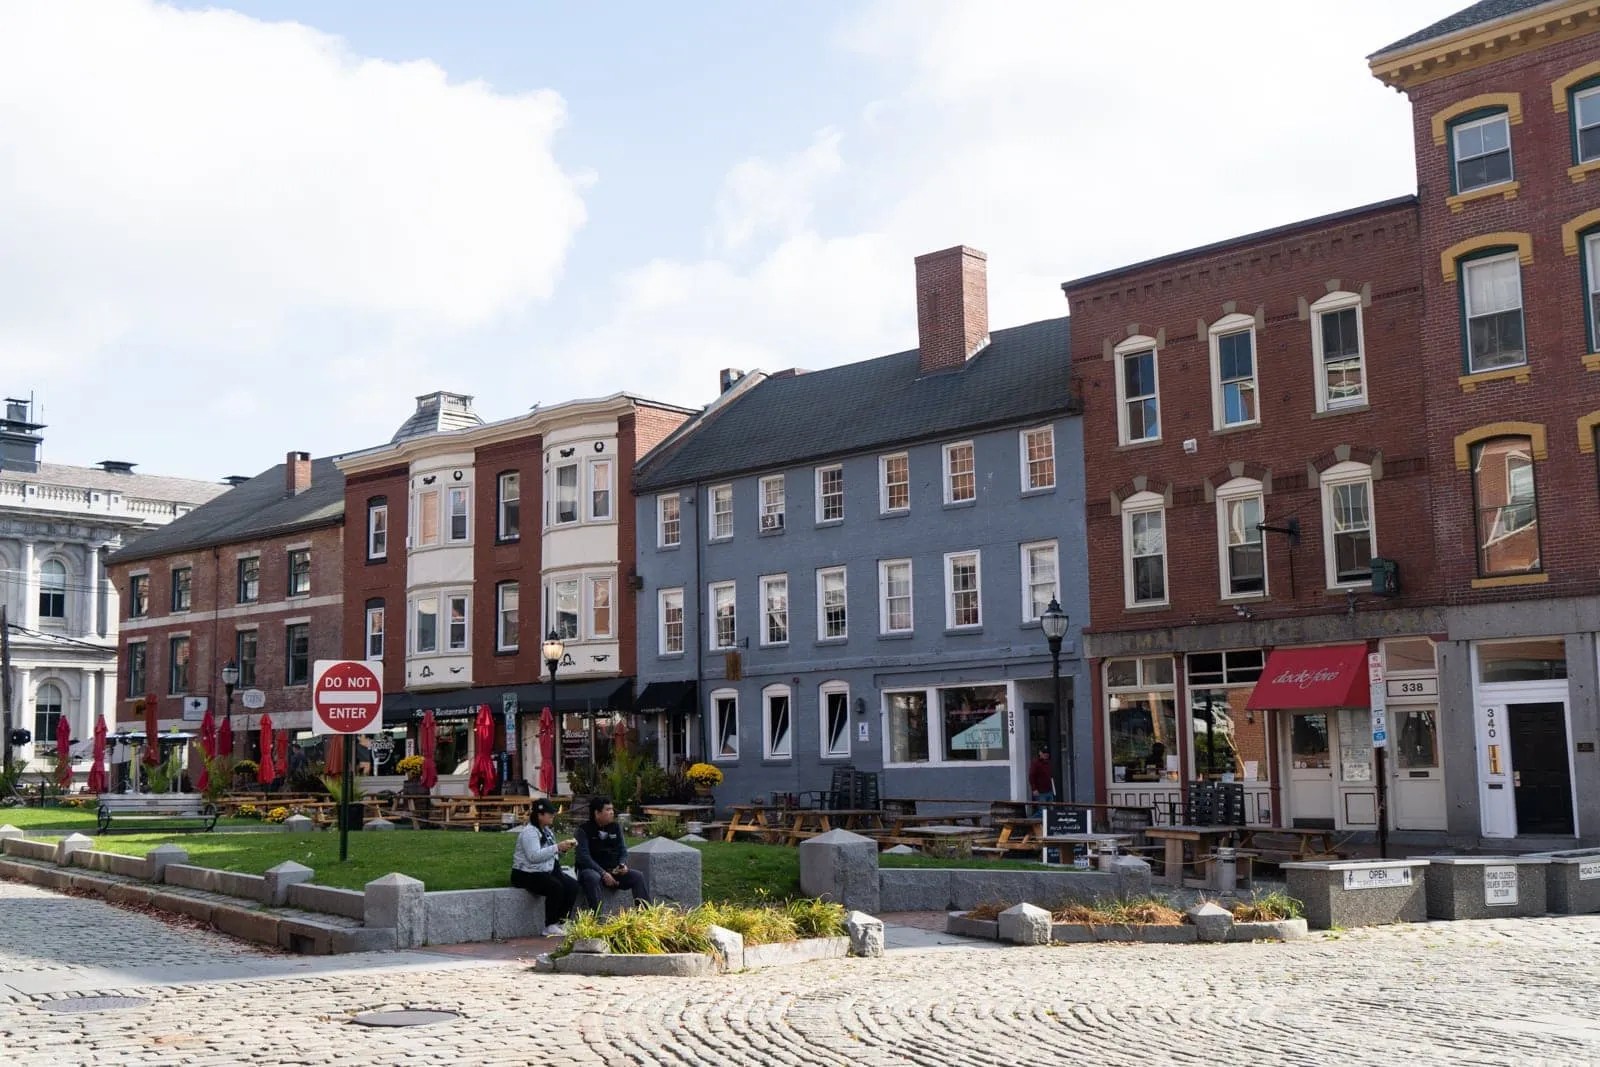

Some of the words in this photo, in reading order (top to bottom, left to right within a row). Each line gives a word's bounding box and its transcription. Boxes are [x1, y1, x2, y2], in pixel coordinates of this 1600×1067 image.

[325, 677, 342, 688] DO
[348, 677, 372, 688] NOT
[1401, 683, 1423, 692] 338
[329, 707, 367, 719] ENTER
[1487, 708, 1496, 738] 340
[1368, 869, 1387, 880] OPEN
